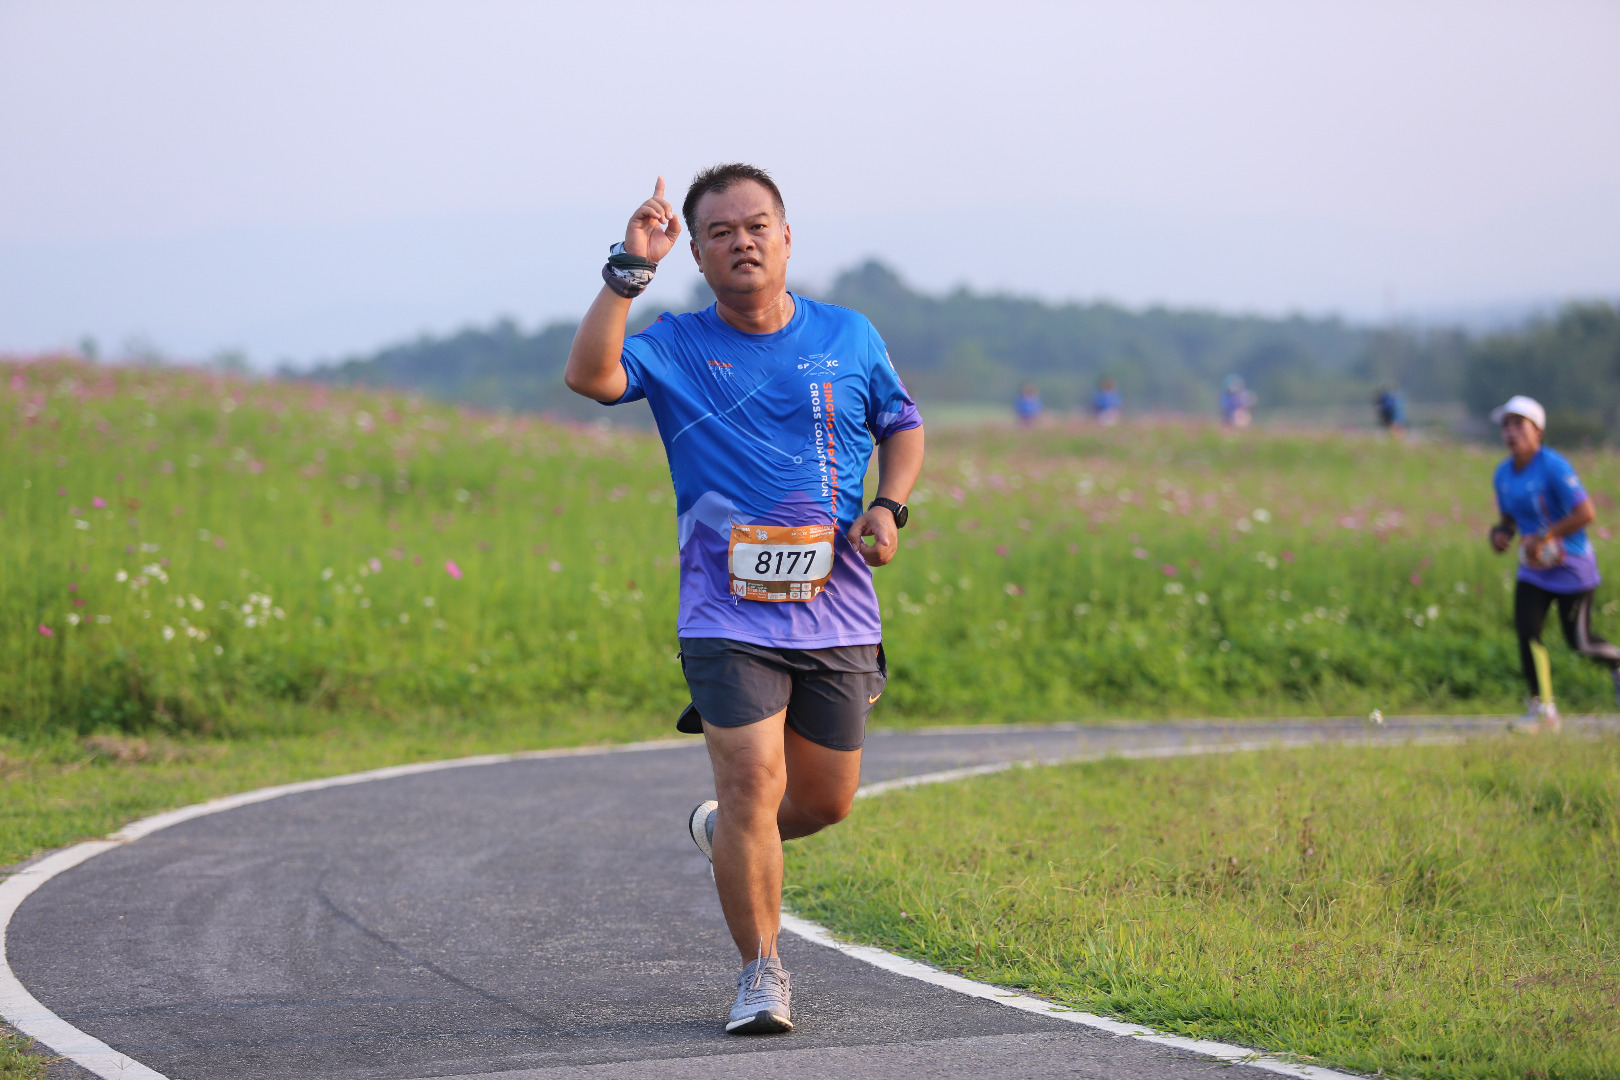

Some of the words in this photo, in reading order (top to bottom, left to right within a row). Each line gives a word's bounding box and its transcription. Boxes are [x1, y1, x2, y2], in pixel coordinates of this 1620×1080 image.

[826, 360, 839, 368] XC
[810, 383, 822, 419] CROSS
[823, 382, 835, 430] SINGHA
[815, 422, 827, 473] COUNTRY
[821, 475, 829, 497] RUN
[755, 550, 817, 575] 8177
[735, 584, 744, 595] M
